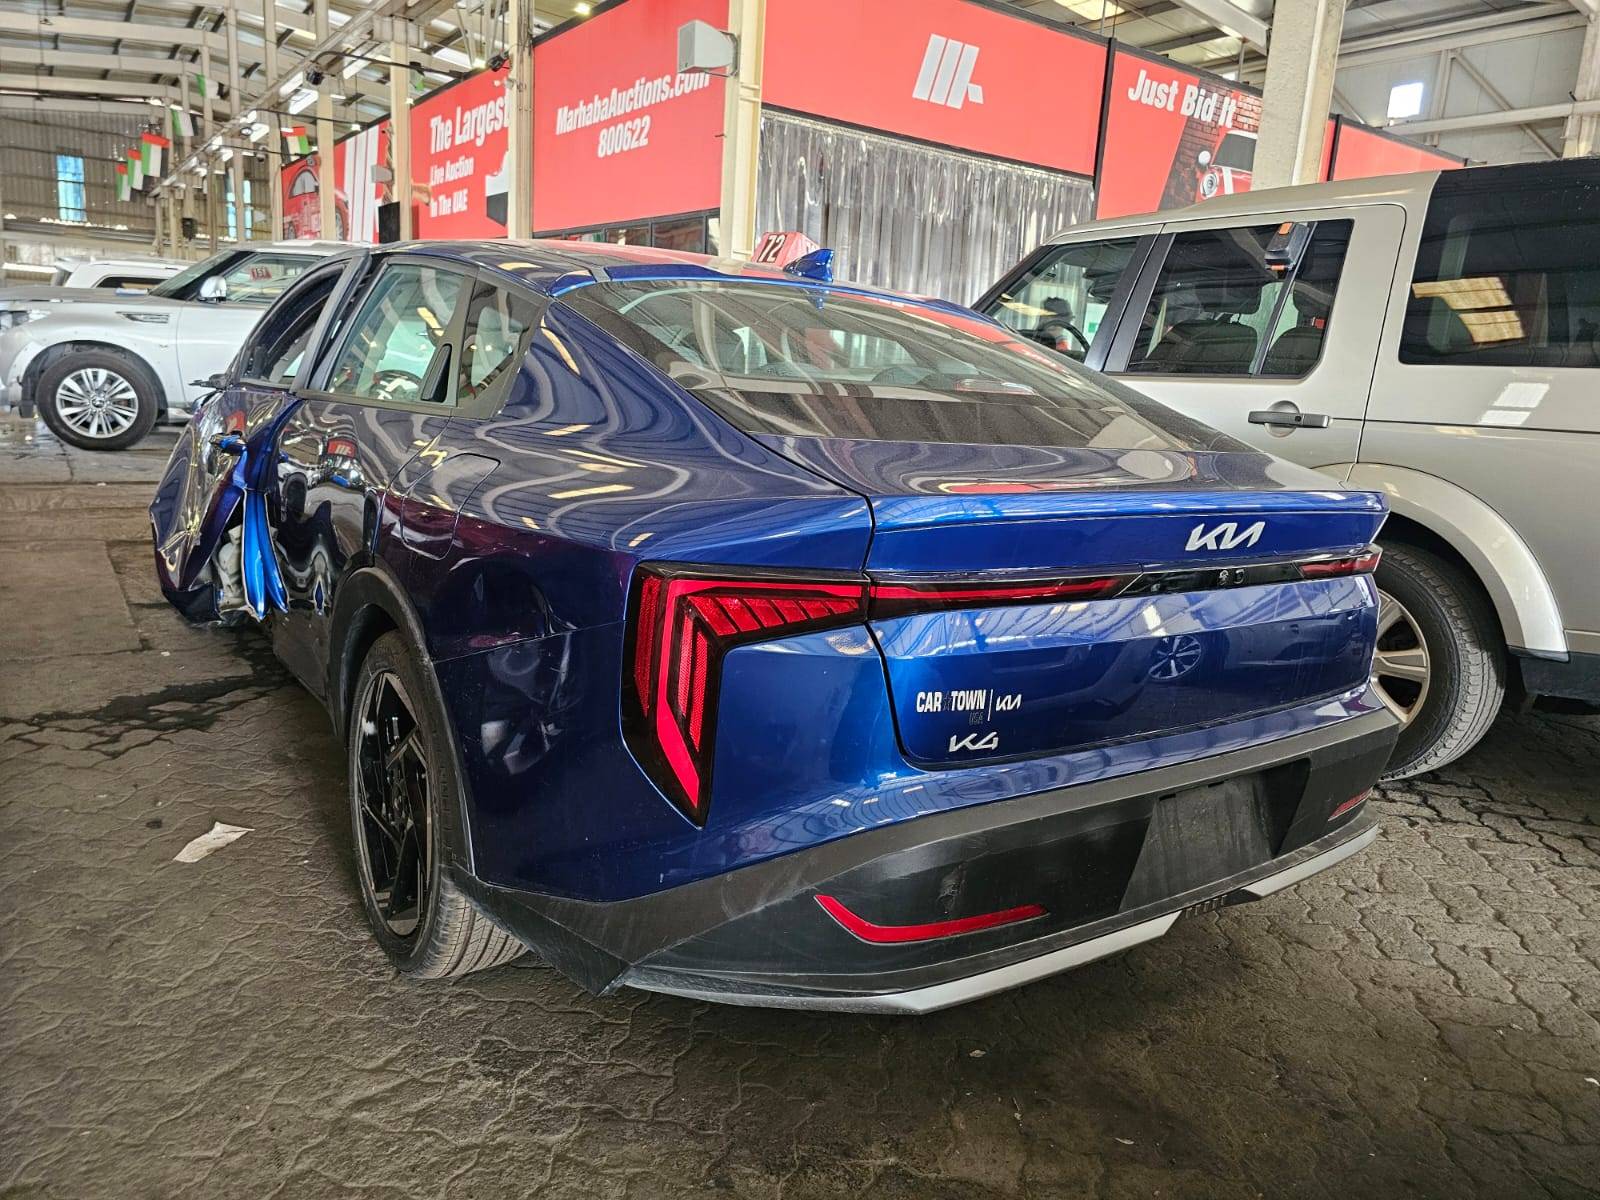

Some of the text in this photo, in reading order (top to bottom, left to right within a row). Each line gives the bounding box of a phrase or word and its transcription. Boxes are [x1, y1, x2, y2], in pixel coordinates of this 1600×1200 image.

[1127, 69, 1236, 129] Just Bid It
[430, 114, 453, 154] The
[597, 114, 651, 158] 800622
[430, 155, 474, 187] Live Auction
[430, 188, 468, 218] In The UAE
[757, 234, 786, 263] 72
[1185, 521, 1266, 551] KIA
[916, 689, 1022, 713] CAR TOWN KIA
[948, 731, 999, 752] K4
